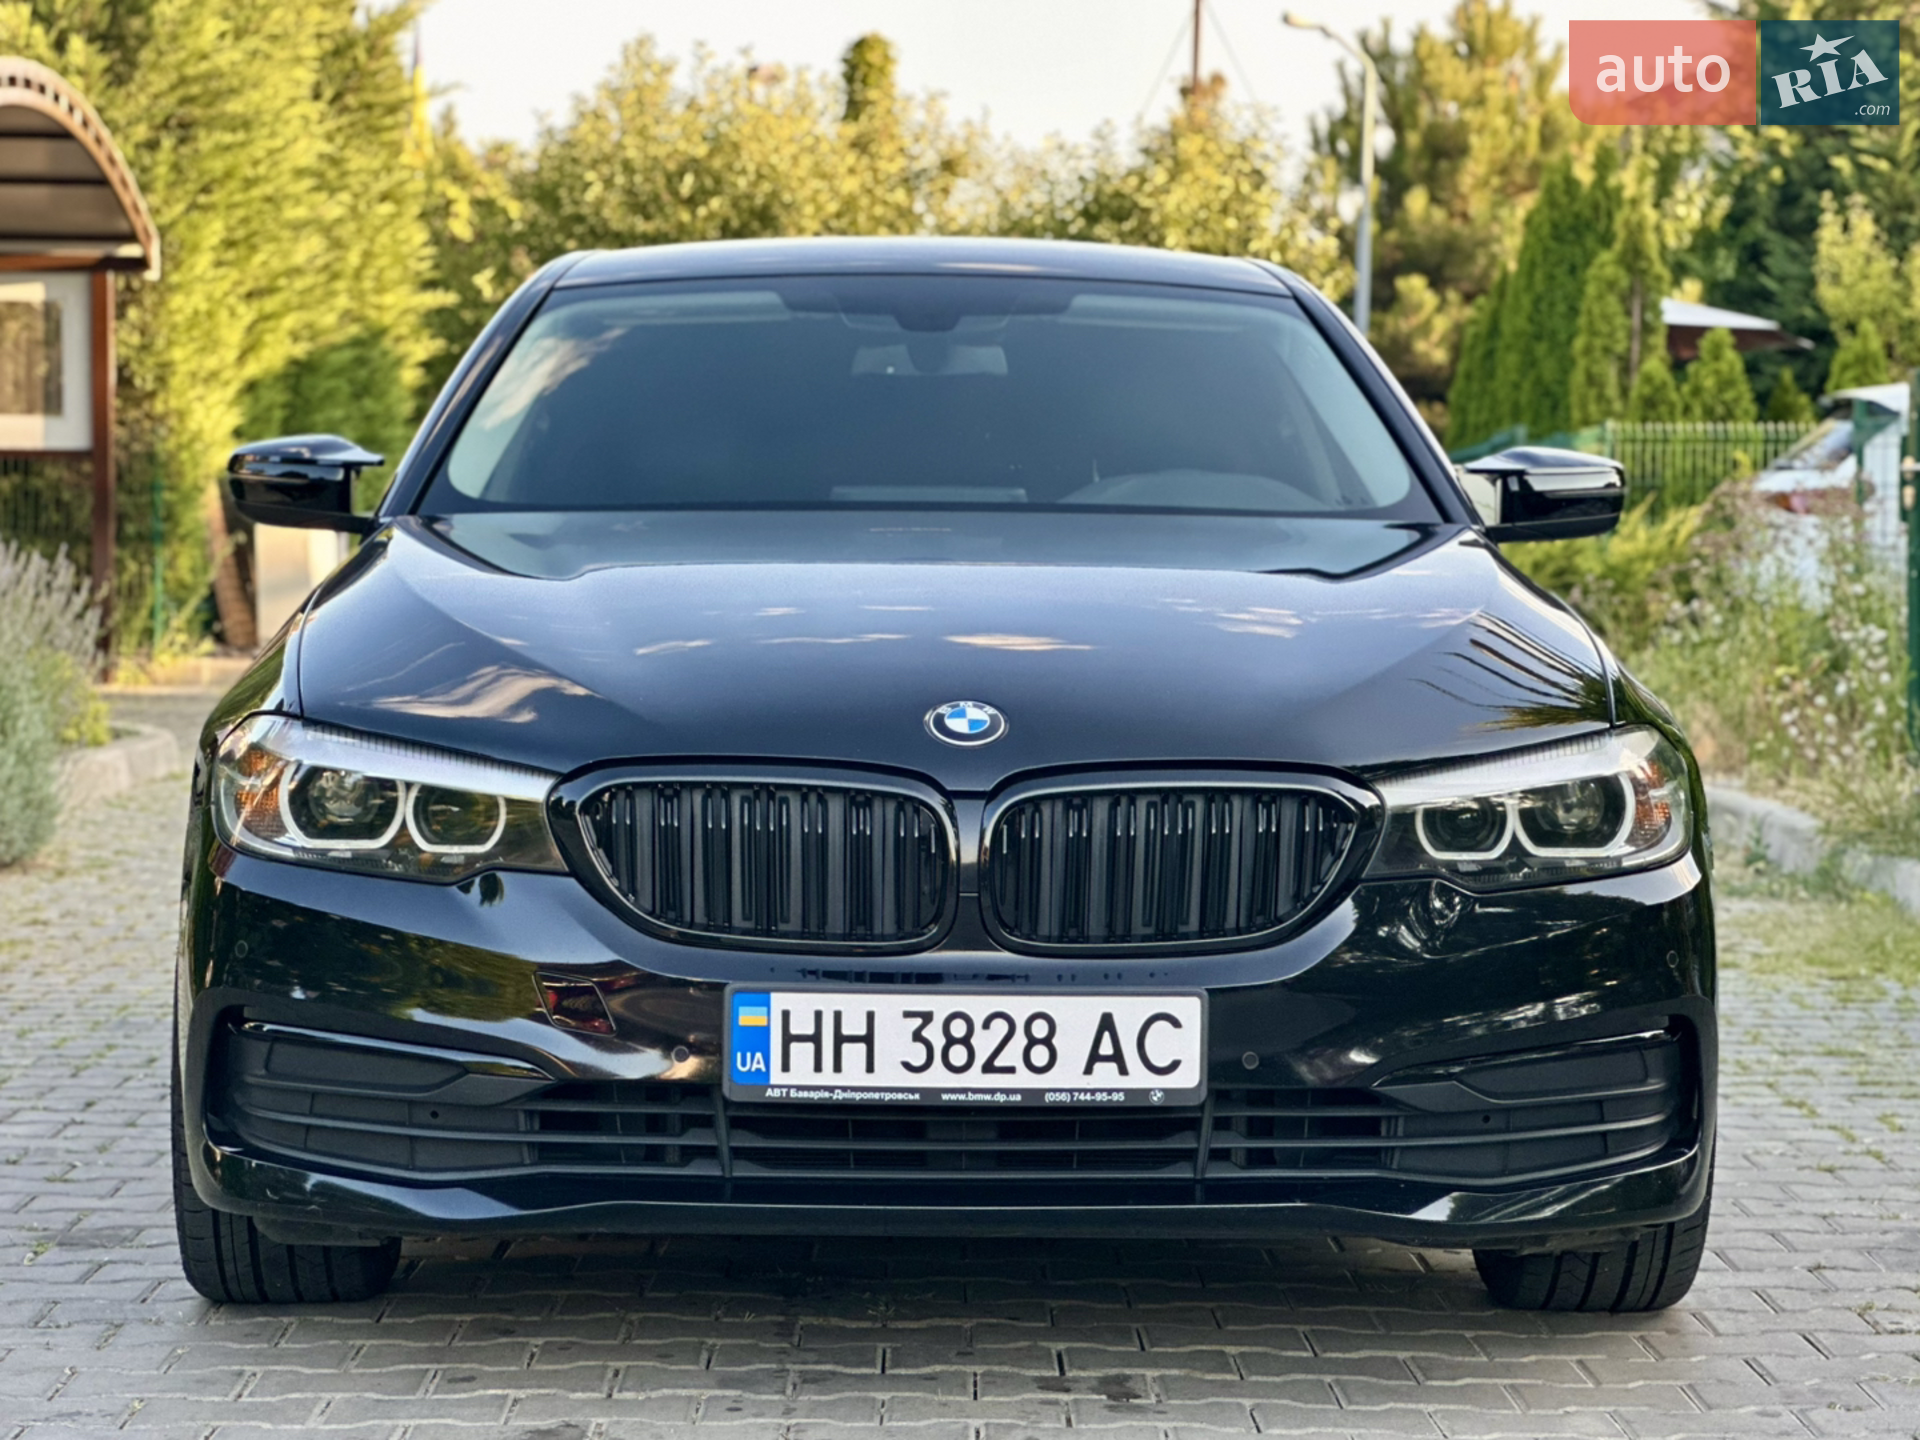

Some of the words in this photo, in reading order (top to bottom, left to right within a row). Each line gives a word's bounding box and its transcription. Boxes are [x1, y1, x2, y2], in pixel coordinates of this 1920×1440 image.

[781, 1009, 875, 1074] HH
[900, 1010, 1058, 1076] 3828
[1082, 1011, 1184, 1077] AC
[736, 1051, 767, 1073] UA
[941, 1091, 1022, 1102] www.bmw.dp.ua
[1044, 1091, 1071, 1103] (056)
[1072, 1091, 1125, 1102] 744-95-95
